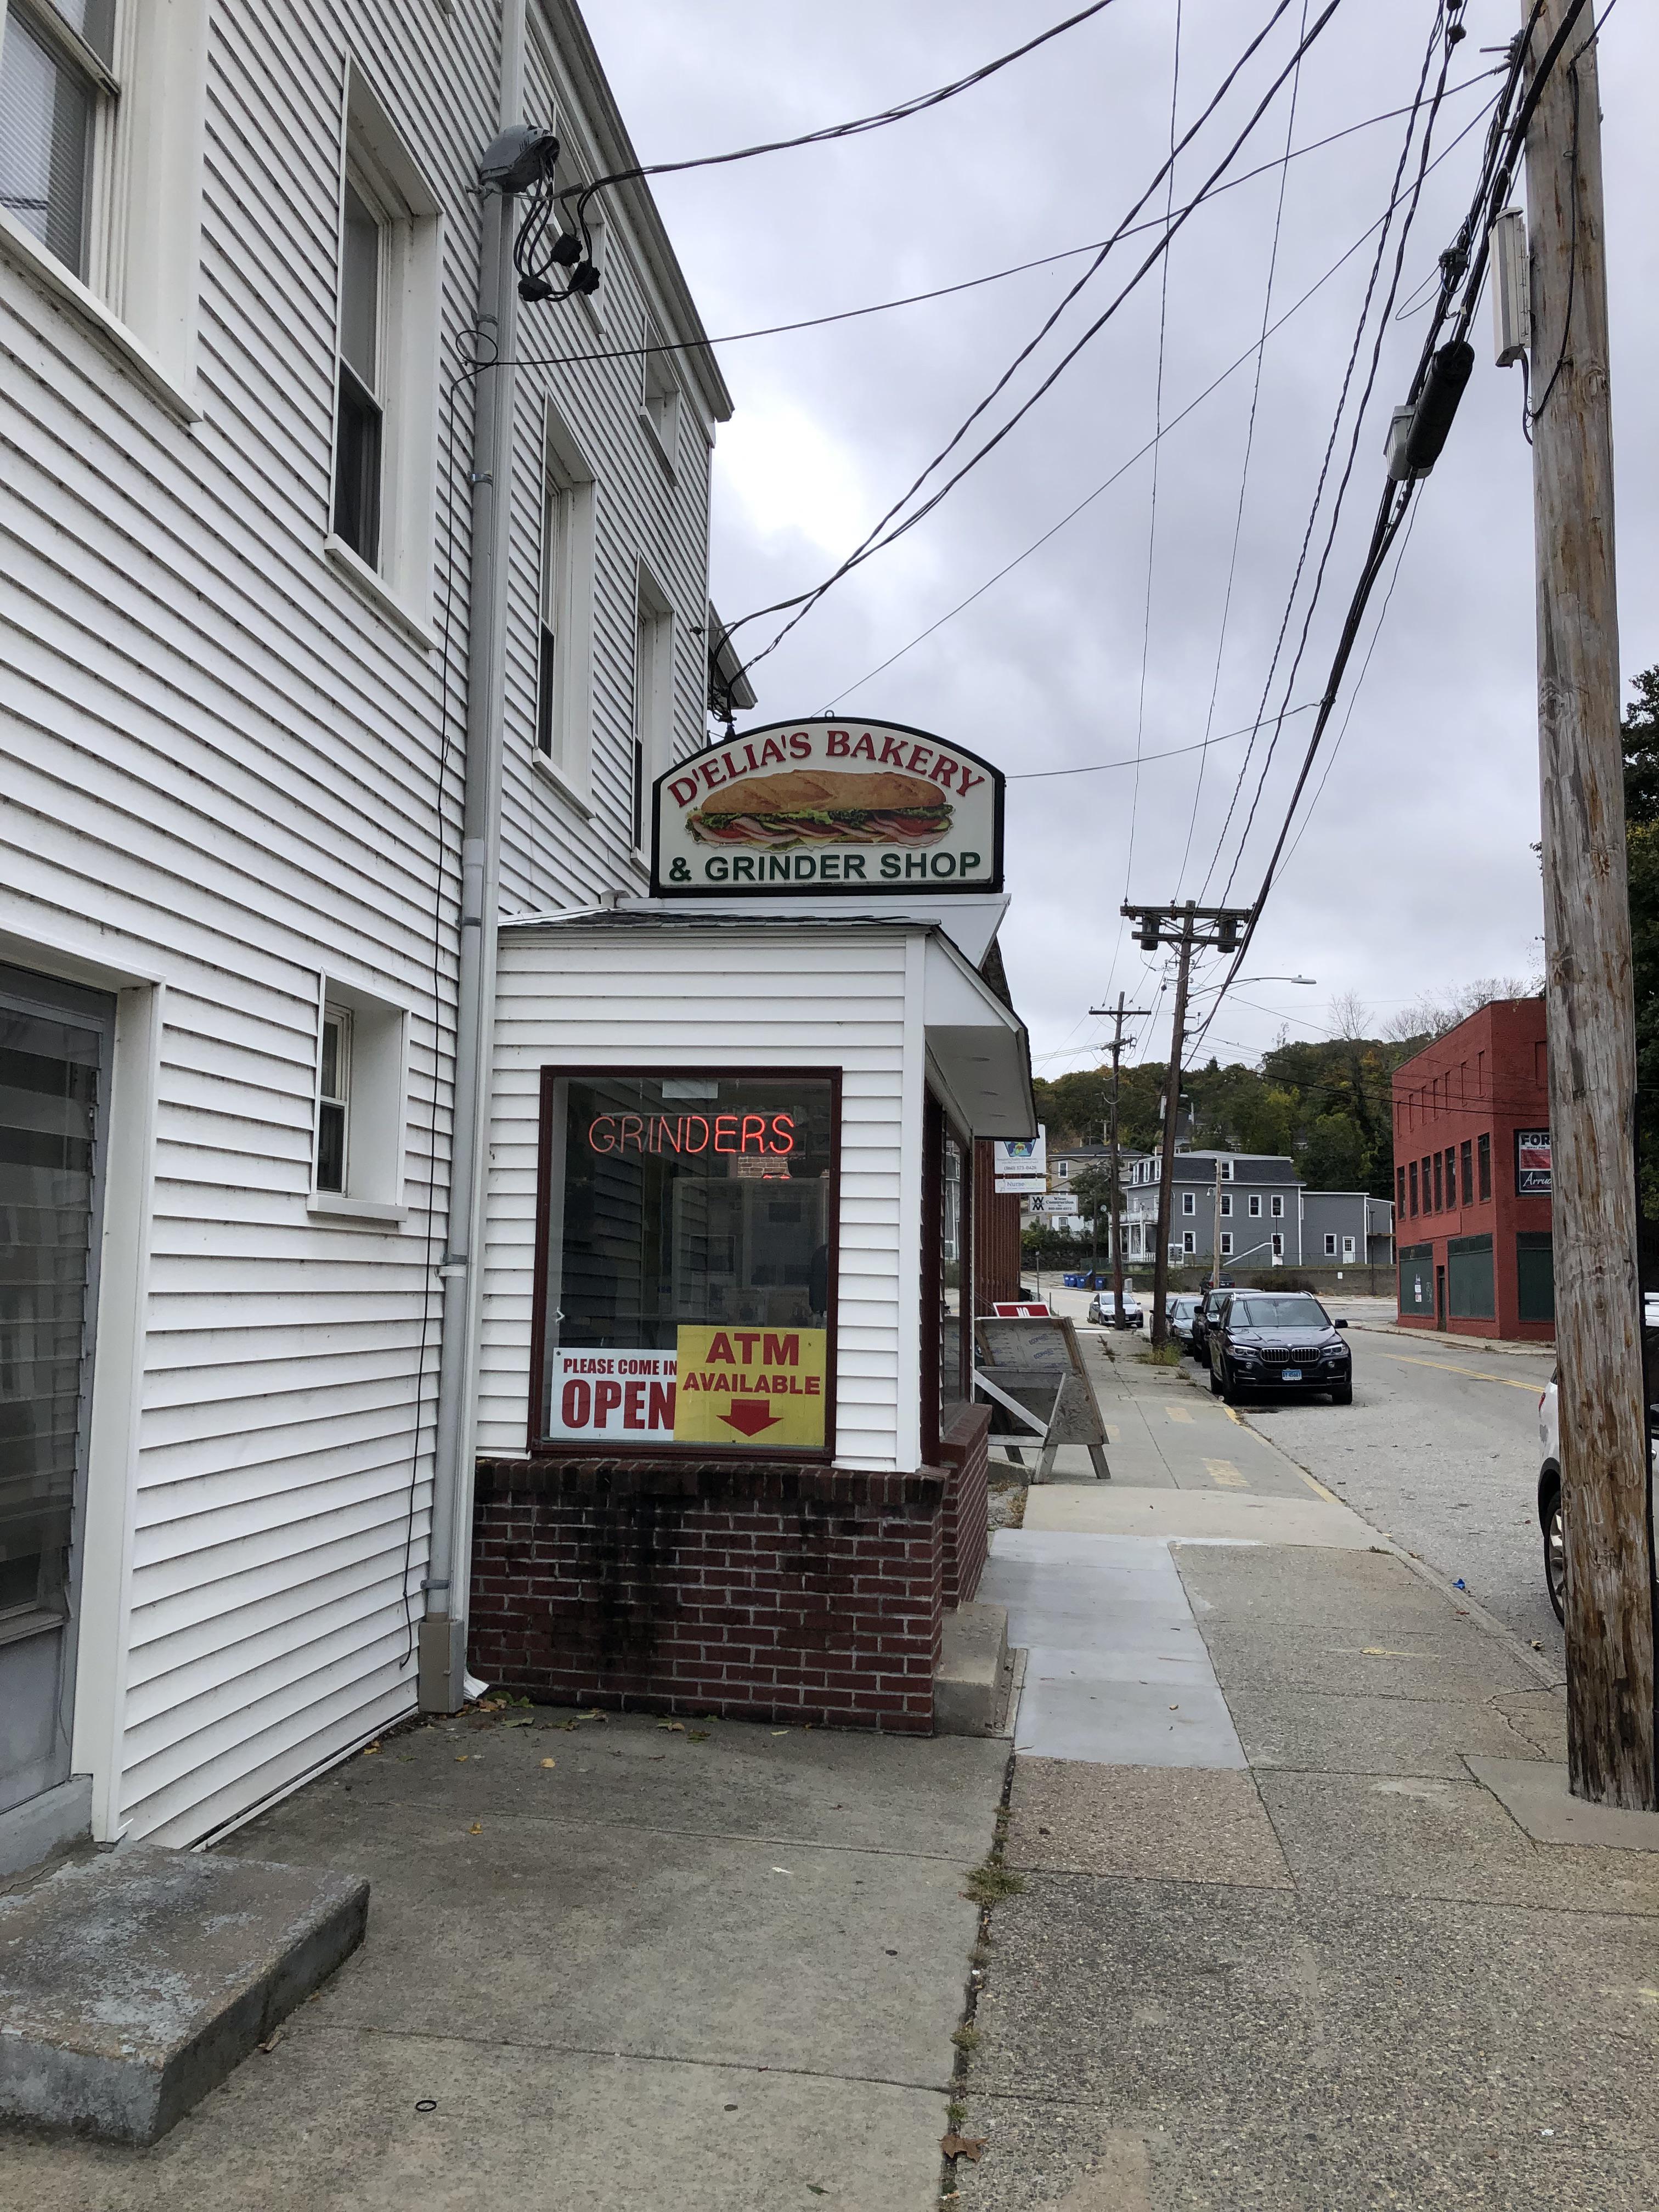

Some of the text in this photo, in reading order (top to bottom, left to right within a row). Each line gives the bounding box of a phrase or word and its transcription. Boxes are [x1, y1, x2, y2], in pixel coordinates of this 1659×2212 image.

[667, 730, 986, 808] D'ELIA'S BAKERY
[669, 851, 981, 881] & GRINDER SHOP
[588, 1115, 795, 1154] GRINDERS
[1521, 1134, 1550, 1146] FOR
[705, 1332, 800, 1366] ATM
[563, 1358, 677, 1375] PLEASE COME IN
[682, 1372, 821, 1395] AVAILABLE
[561, 1379, 676, 1430] OPEN
